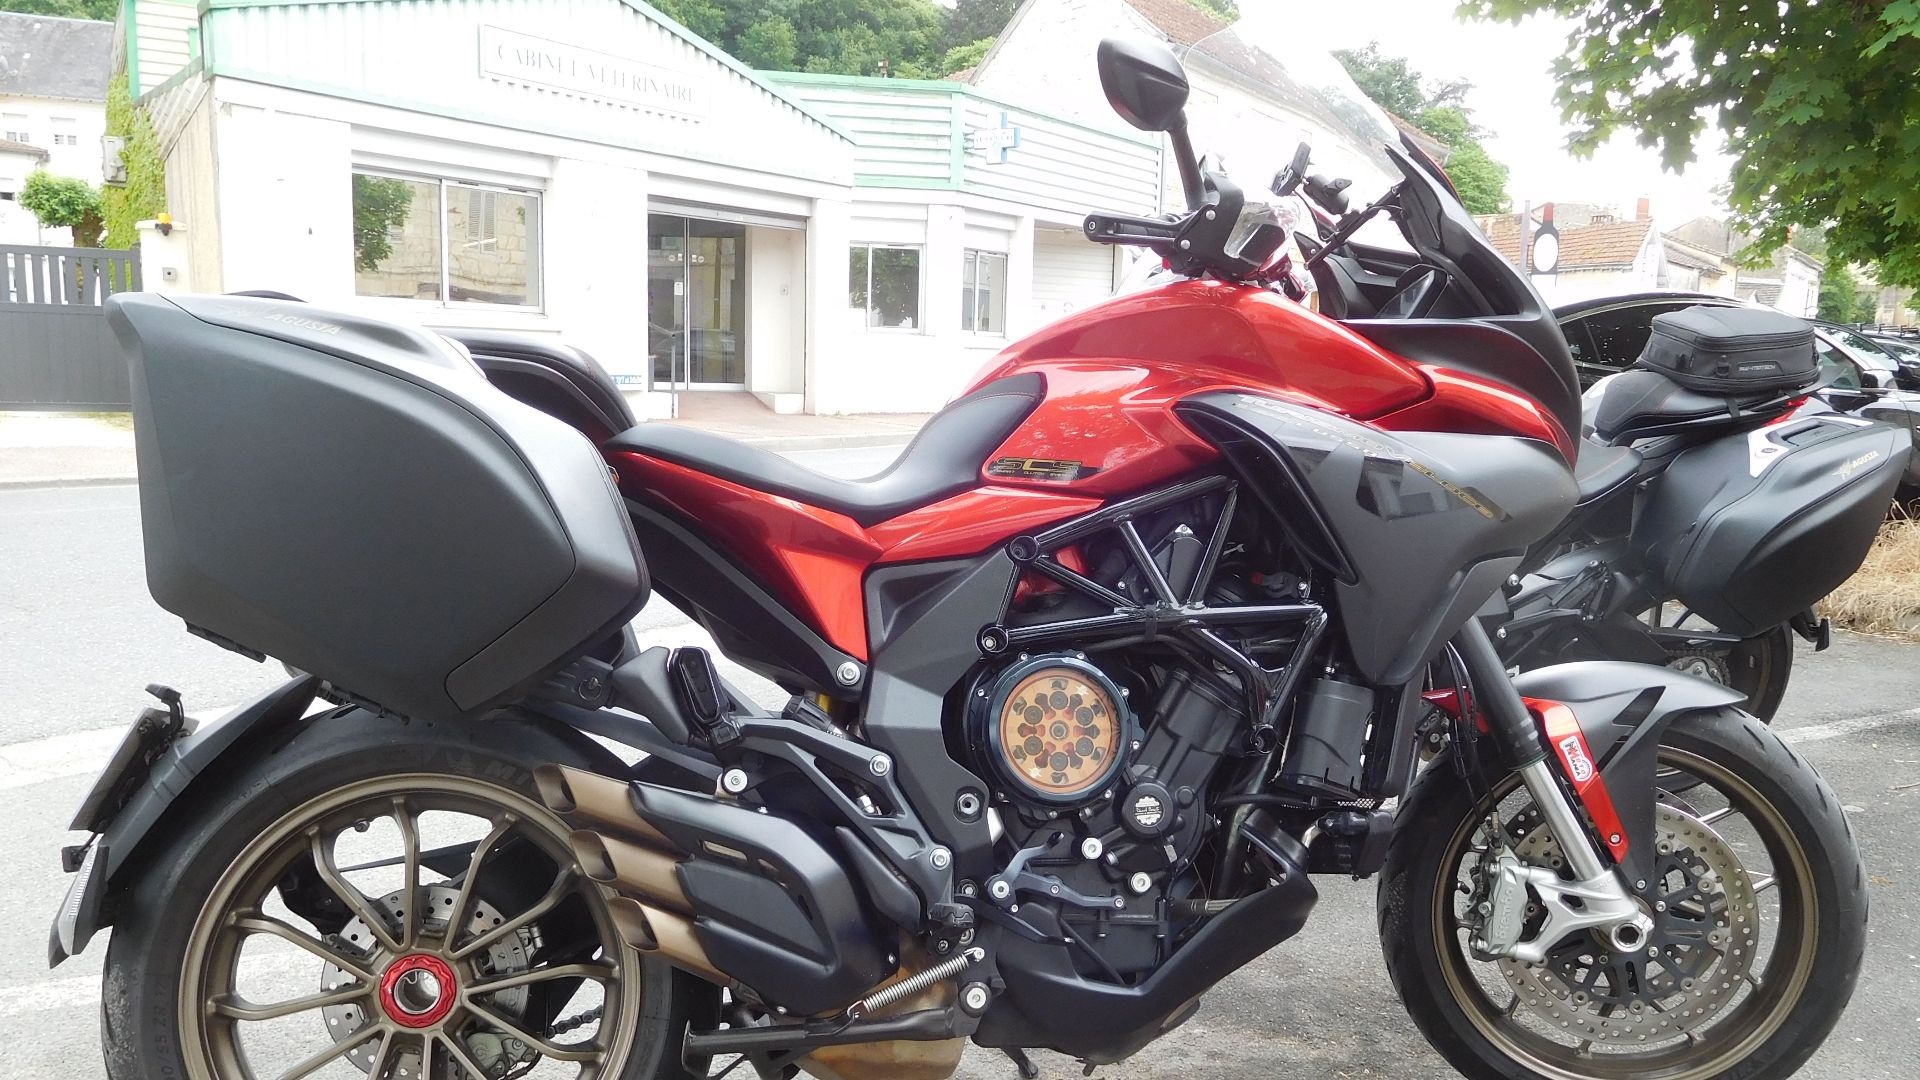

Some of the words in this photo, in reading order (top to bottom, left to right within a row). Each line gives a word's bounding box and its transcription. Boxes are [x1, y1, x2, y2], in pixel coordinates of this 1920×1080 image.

[265, 312, 343, 336] AGUSTA
[995, 456, 1082, 473] SCS
[1494, 888, 1514, 939] brembo
